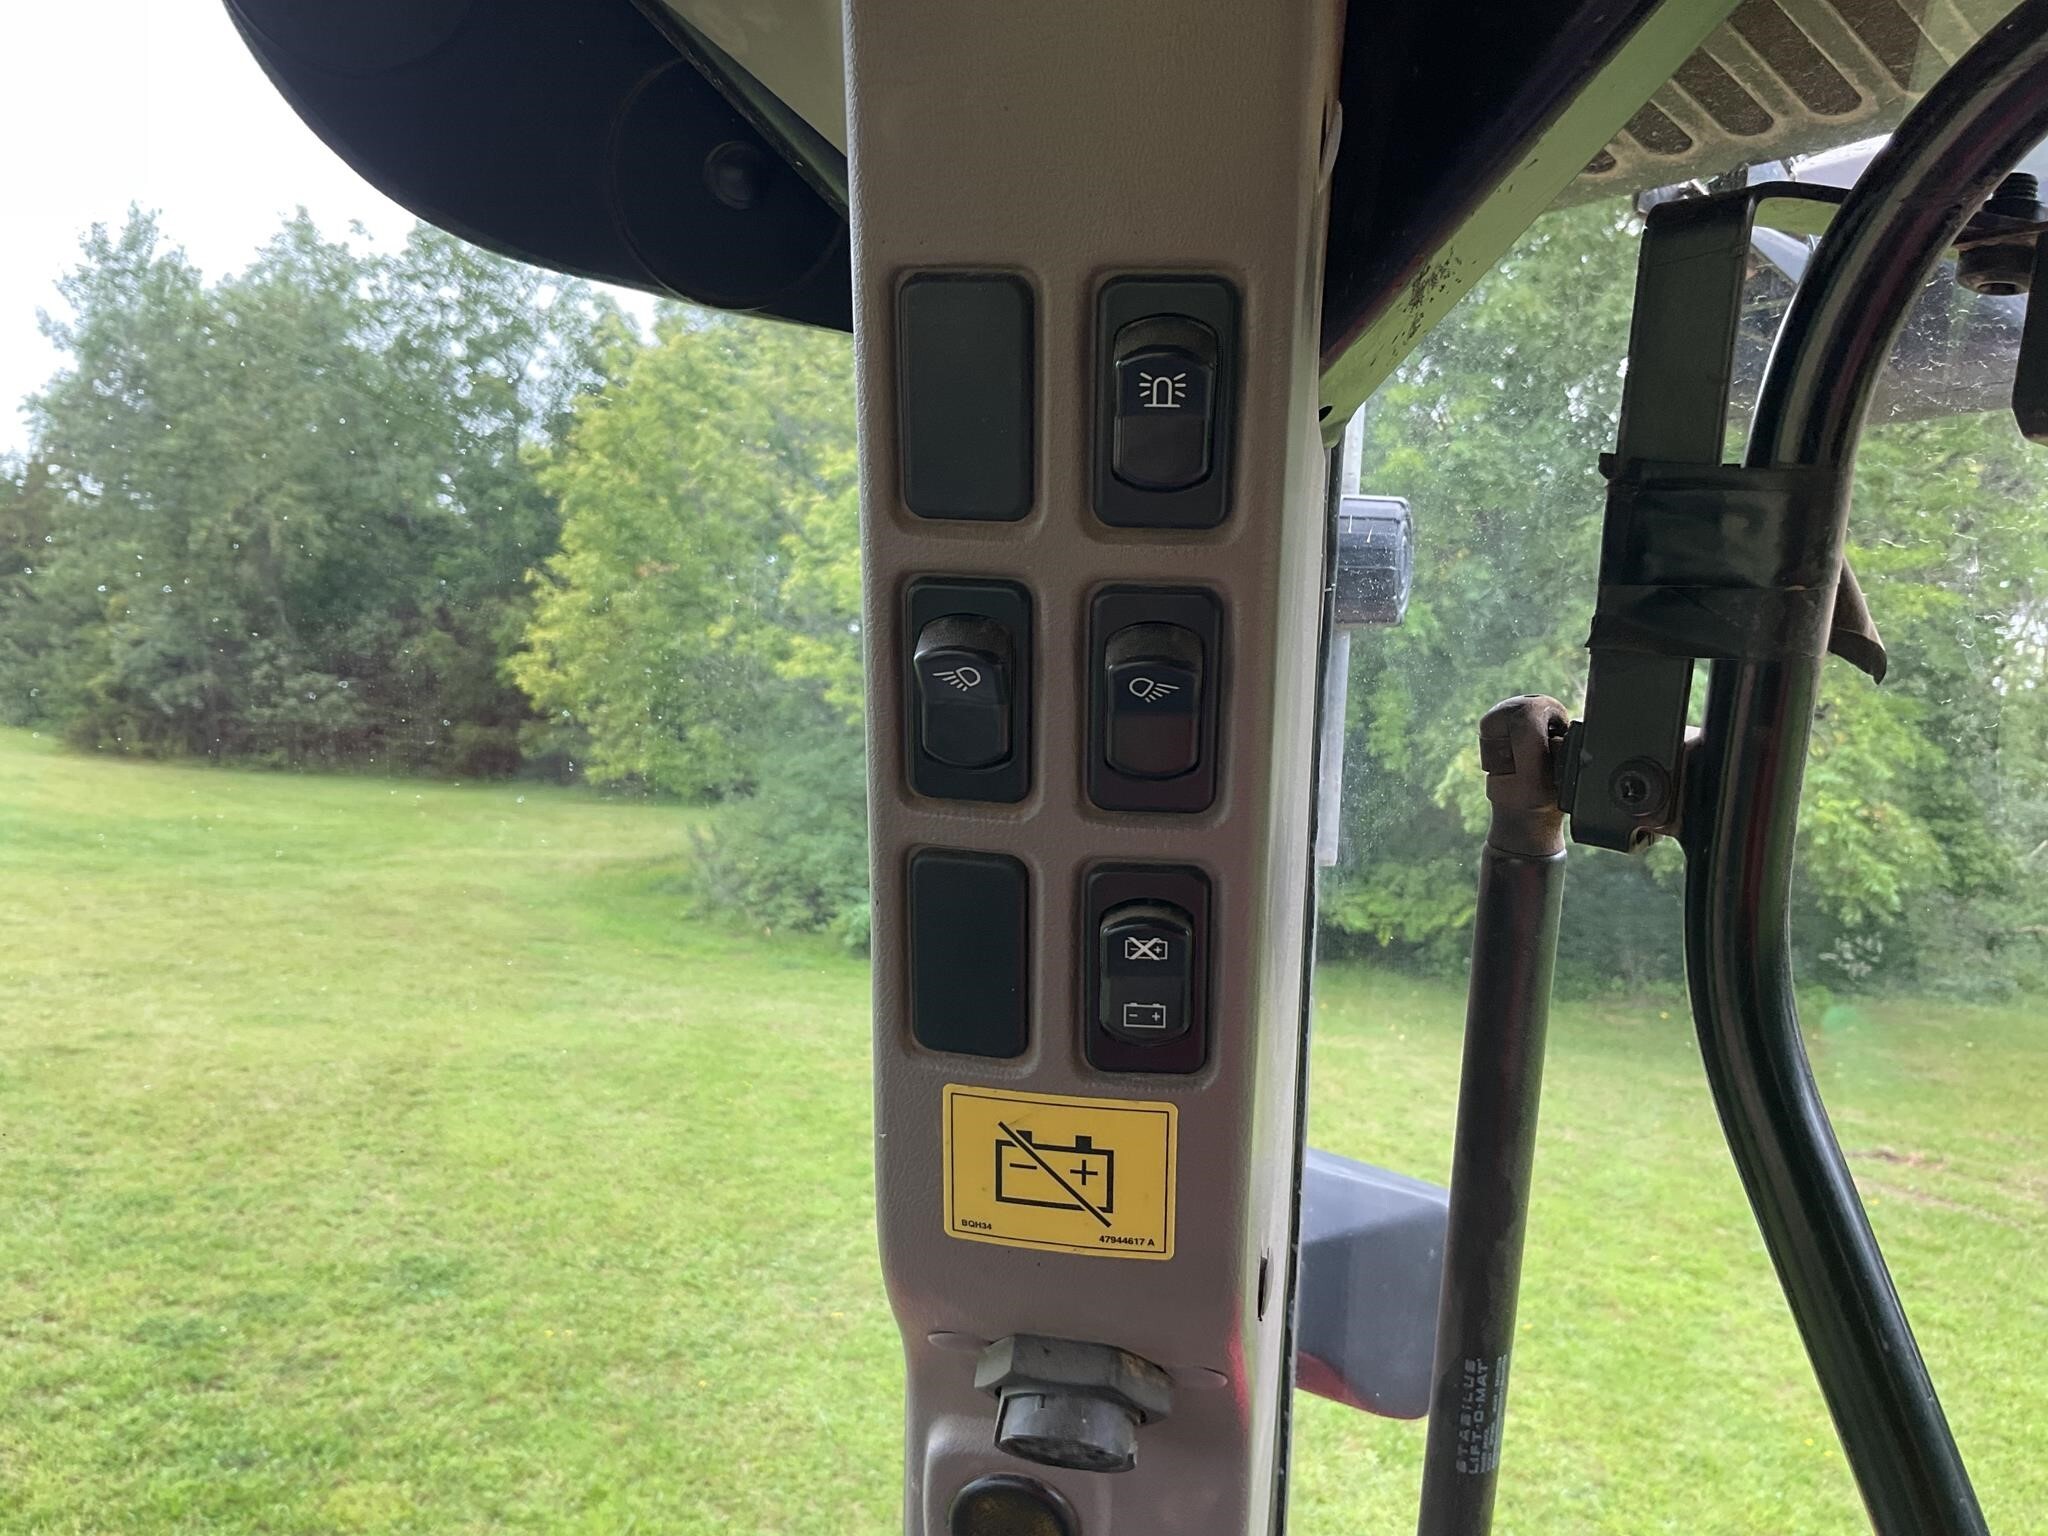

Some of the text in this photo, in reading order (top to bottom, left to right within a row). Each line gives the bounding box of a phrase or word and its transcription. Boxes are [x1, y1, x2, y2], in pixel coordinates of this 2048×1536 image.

[961, 1219, 992, 1230] BQH34
[1099, 1235, 1155, 1246] 47944617 A
[1456, 1359, 1476, 1473] STABILUS
